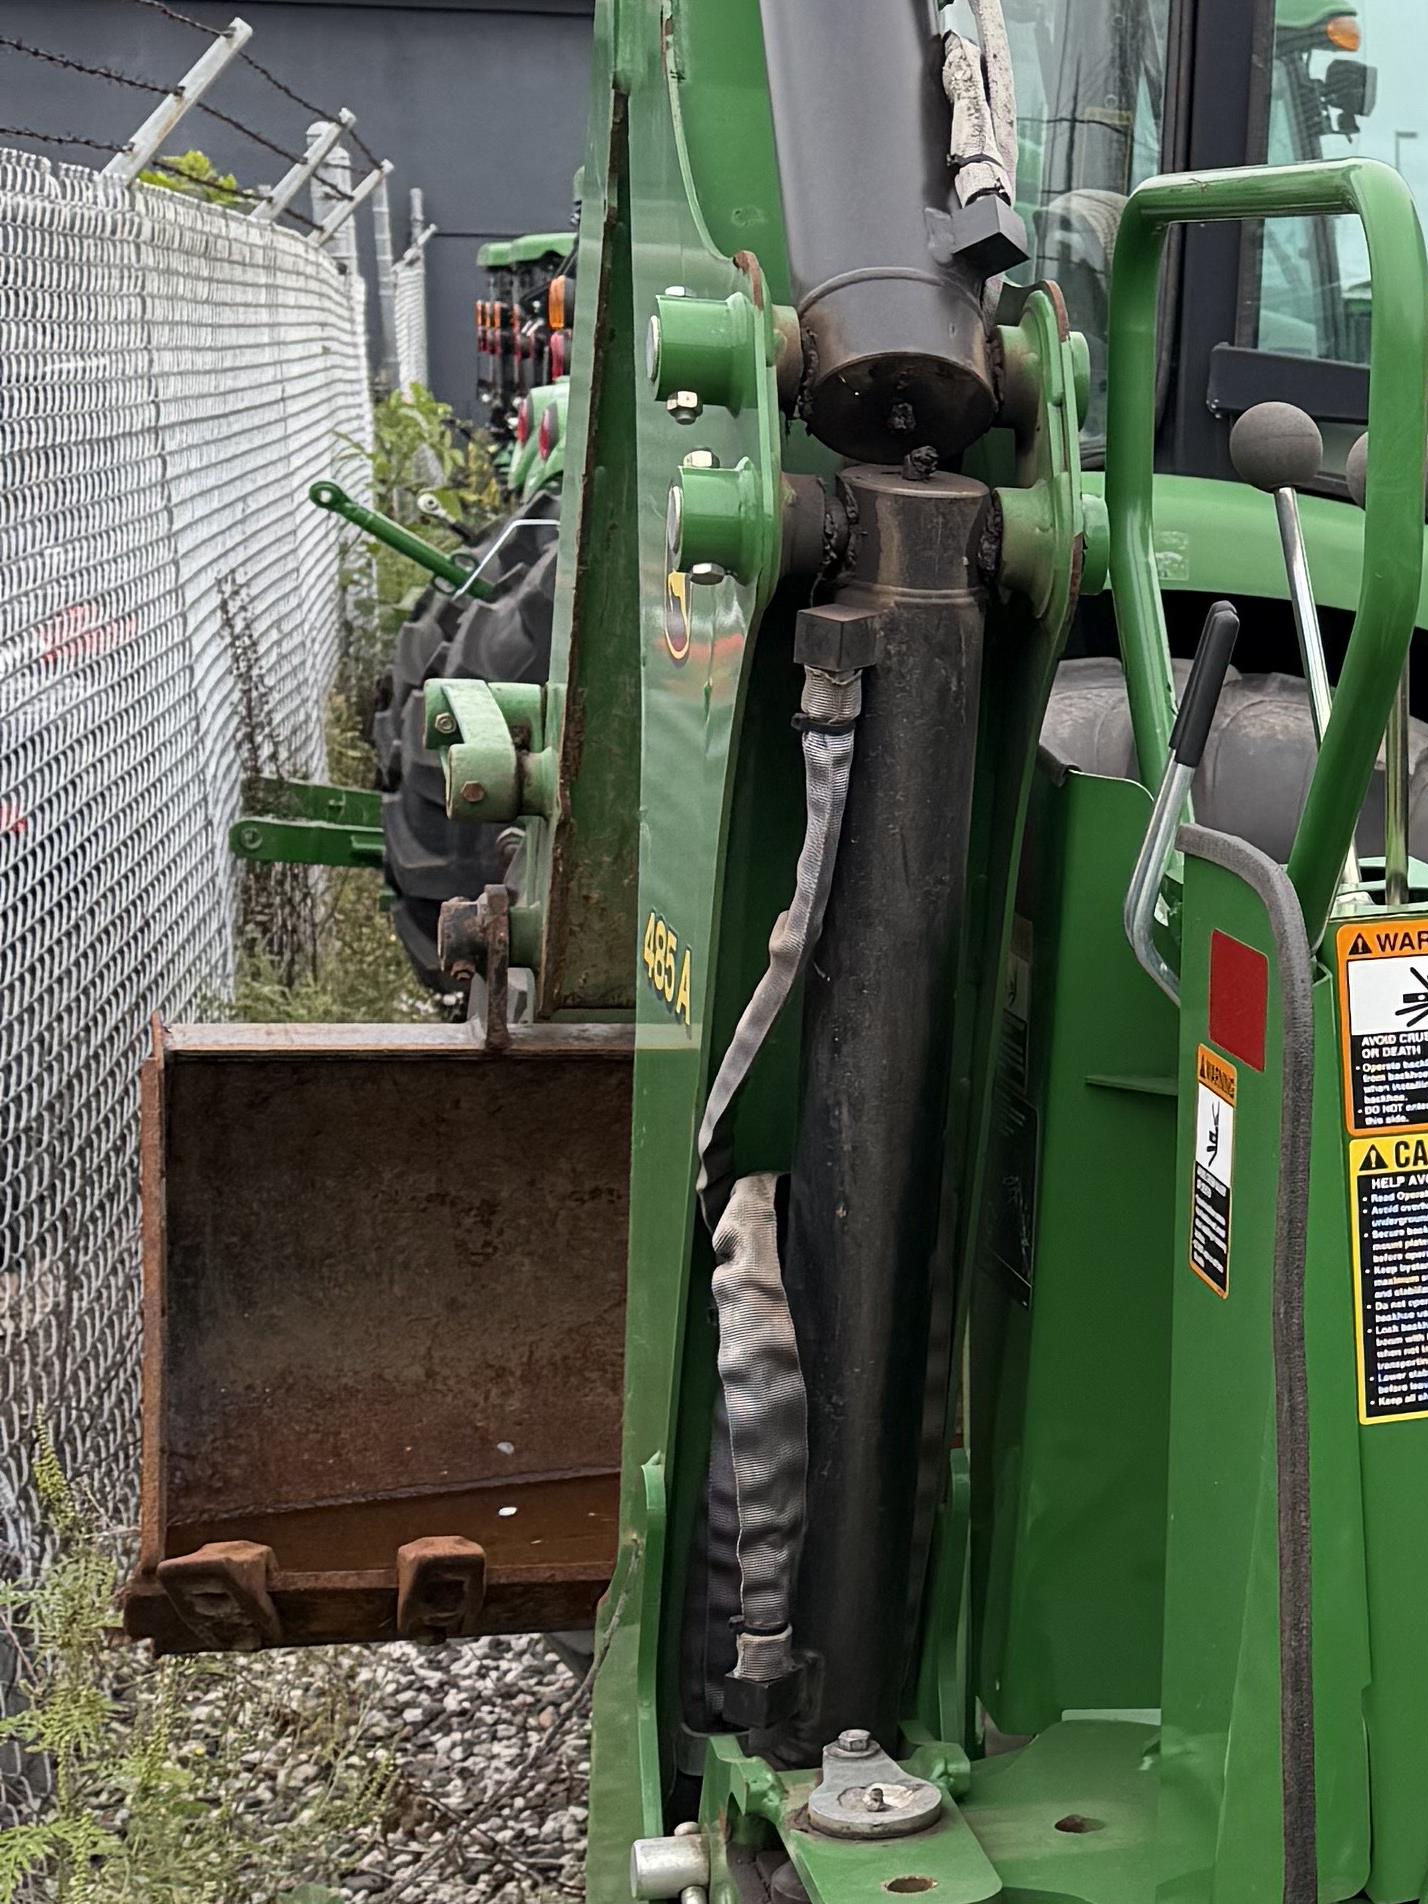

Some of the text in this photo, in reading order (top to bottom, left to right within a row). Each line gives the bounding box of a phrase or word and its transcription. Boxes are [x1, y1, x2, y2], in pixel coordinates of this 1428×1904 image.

[1362, 1035, 1397, 1046] AVOID
[1362, 1045, 1421, 1059] OR DEATH
[1365, 1106, 1380, 1115] DO
[1382, 1104, 1404, 1114] NOT
[1371, 1176, 1405, 1190] HELP
[1371, 1204, 1399, 1216] Avoid
[1375, 1302, 1389, 1311] Do
